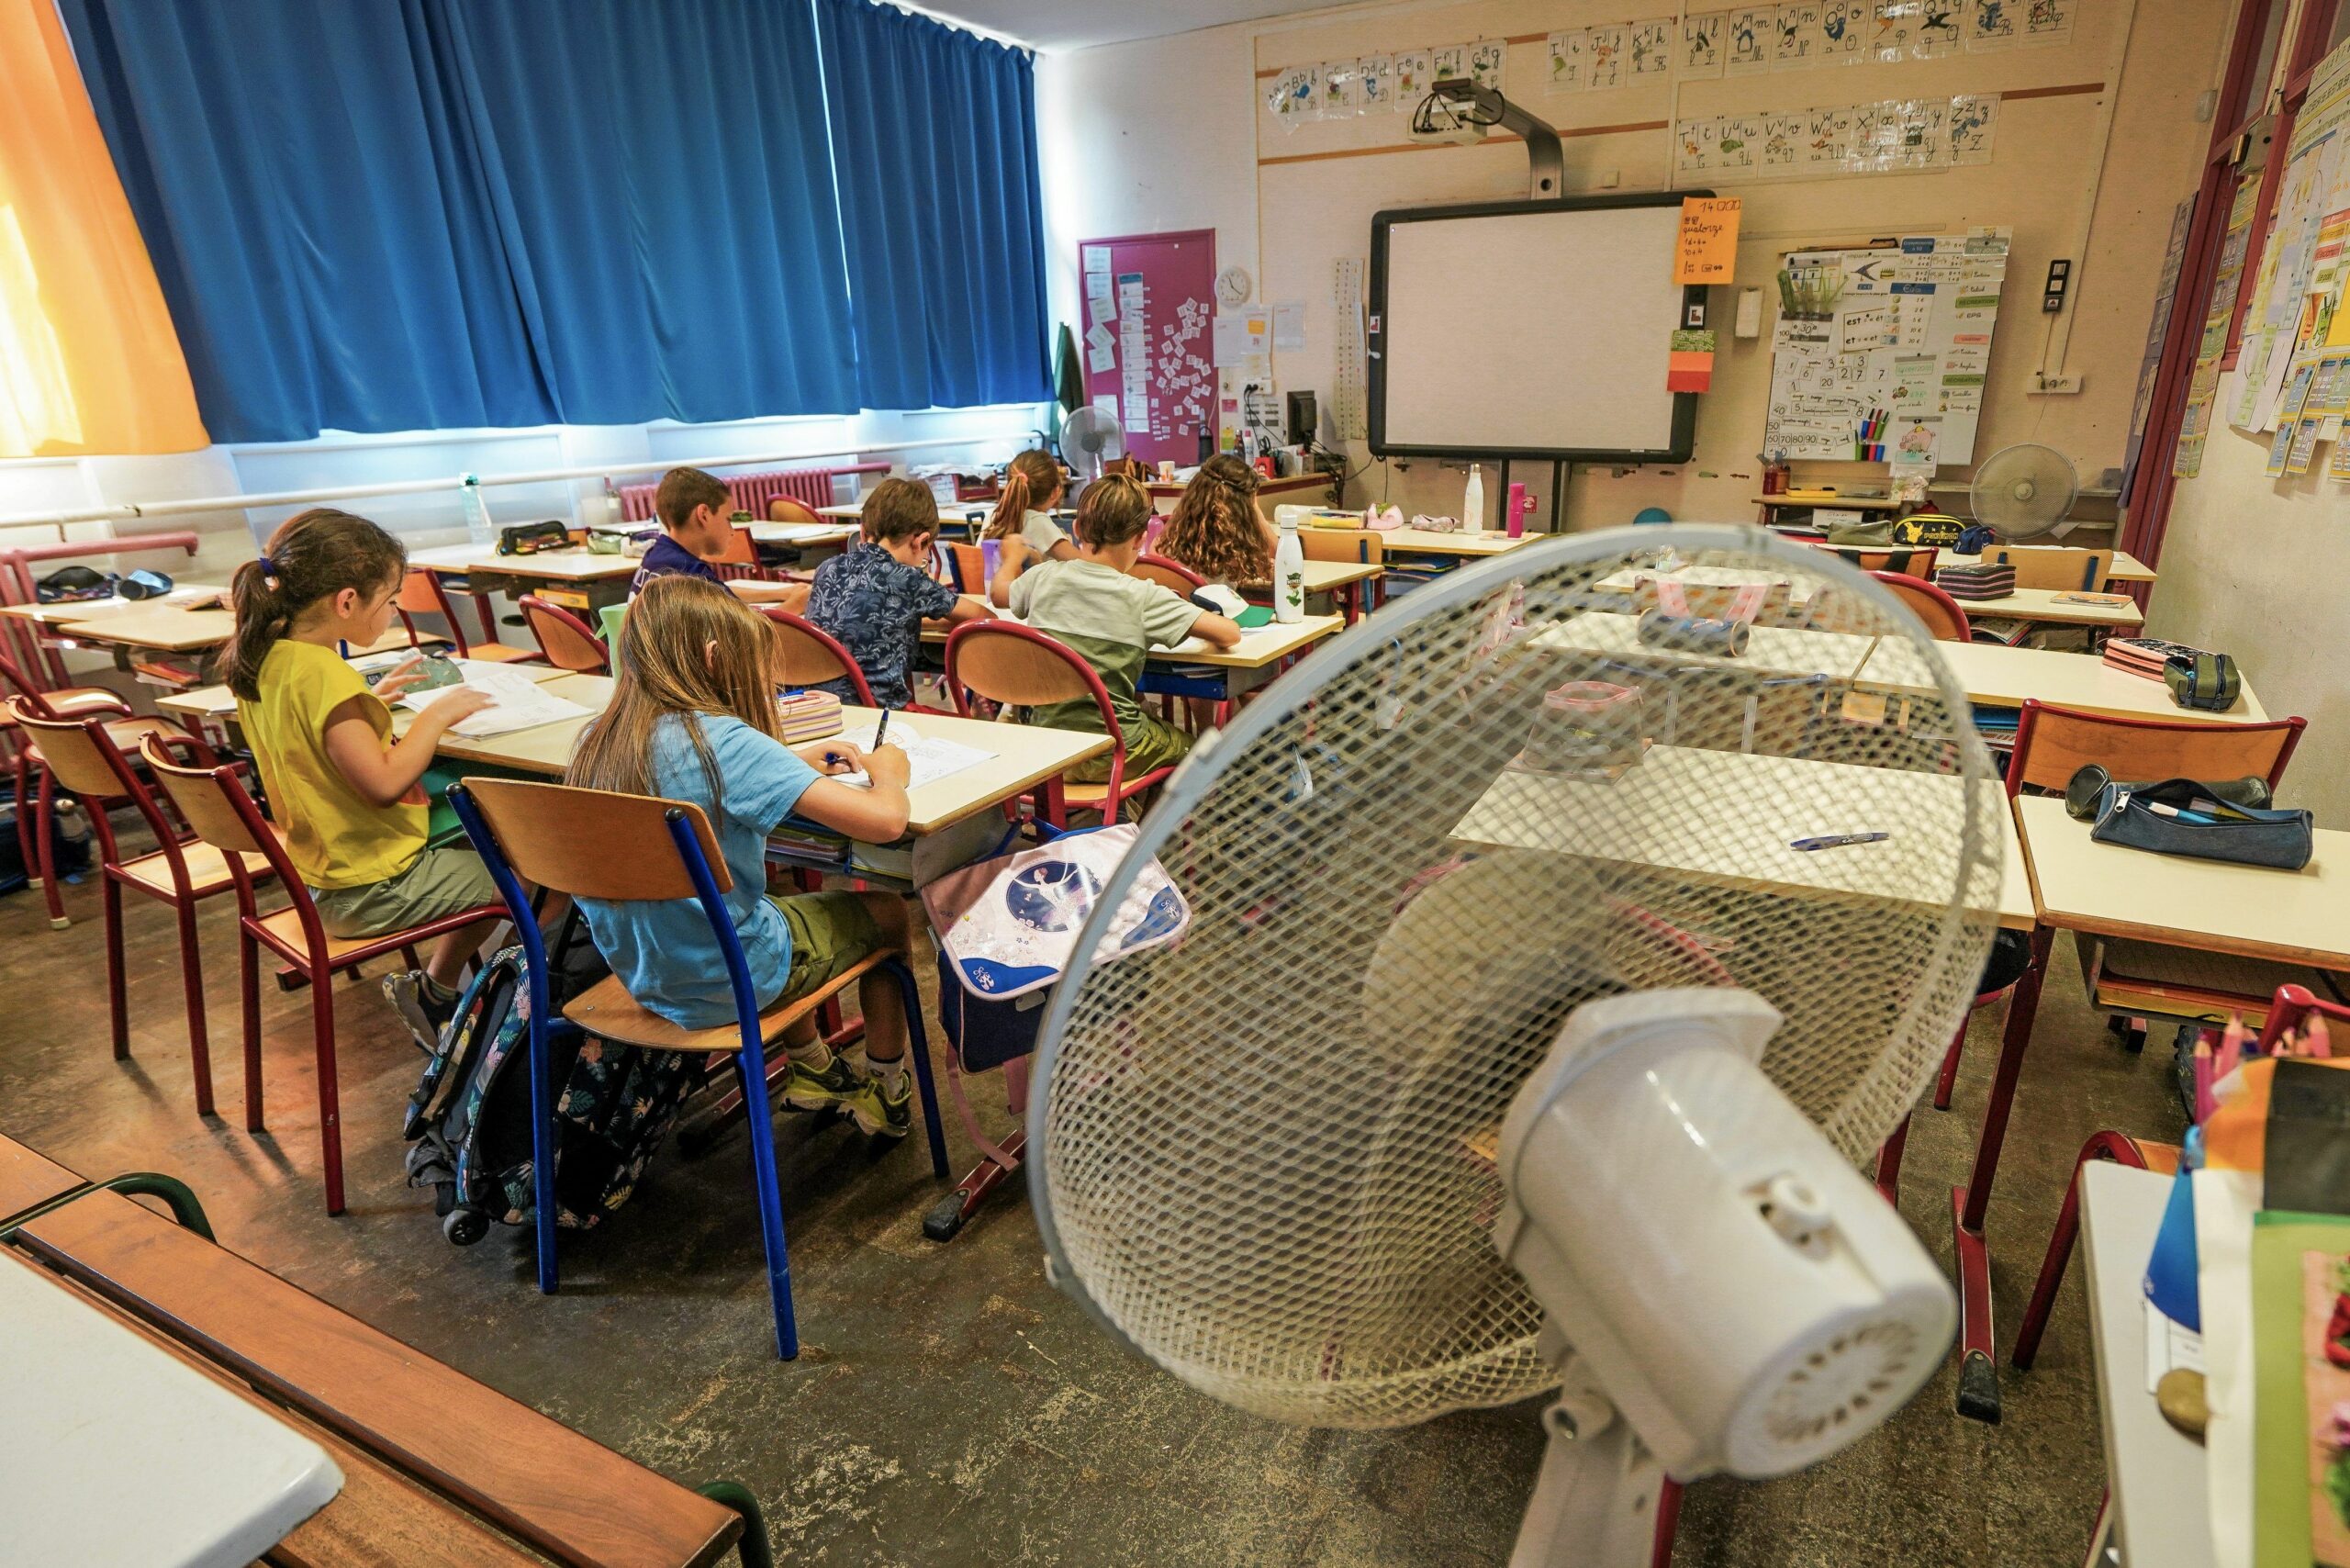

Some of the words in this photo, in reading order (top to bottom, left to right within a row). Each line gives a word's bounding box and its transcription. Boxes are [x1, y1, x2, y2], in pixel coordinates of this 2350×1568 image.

[1846, 318, 1864, 326] est
[1857, 355, 1864, 367] 3
[1841, 368, 1848, 379] 2
[1821, 378, 1833, 386] 20
[1856, 407, 1864, 417] 8
[1768, 421, 1779, 431] 50
[1768, 435, 1779, 443] 60
[1782, 435, 1791, 443] 70
[1793, 435, 1803, 443] 80
[1805, 434, 1817, 443] 90
